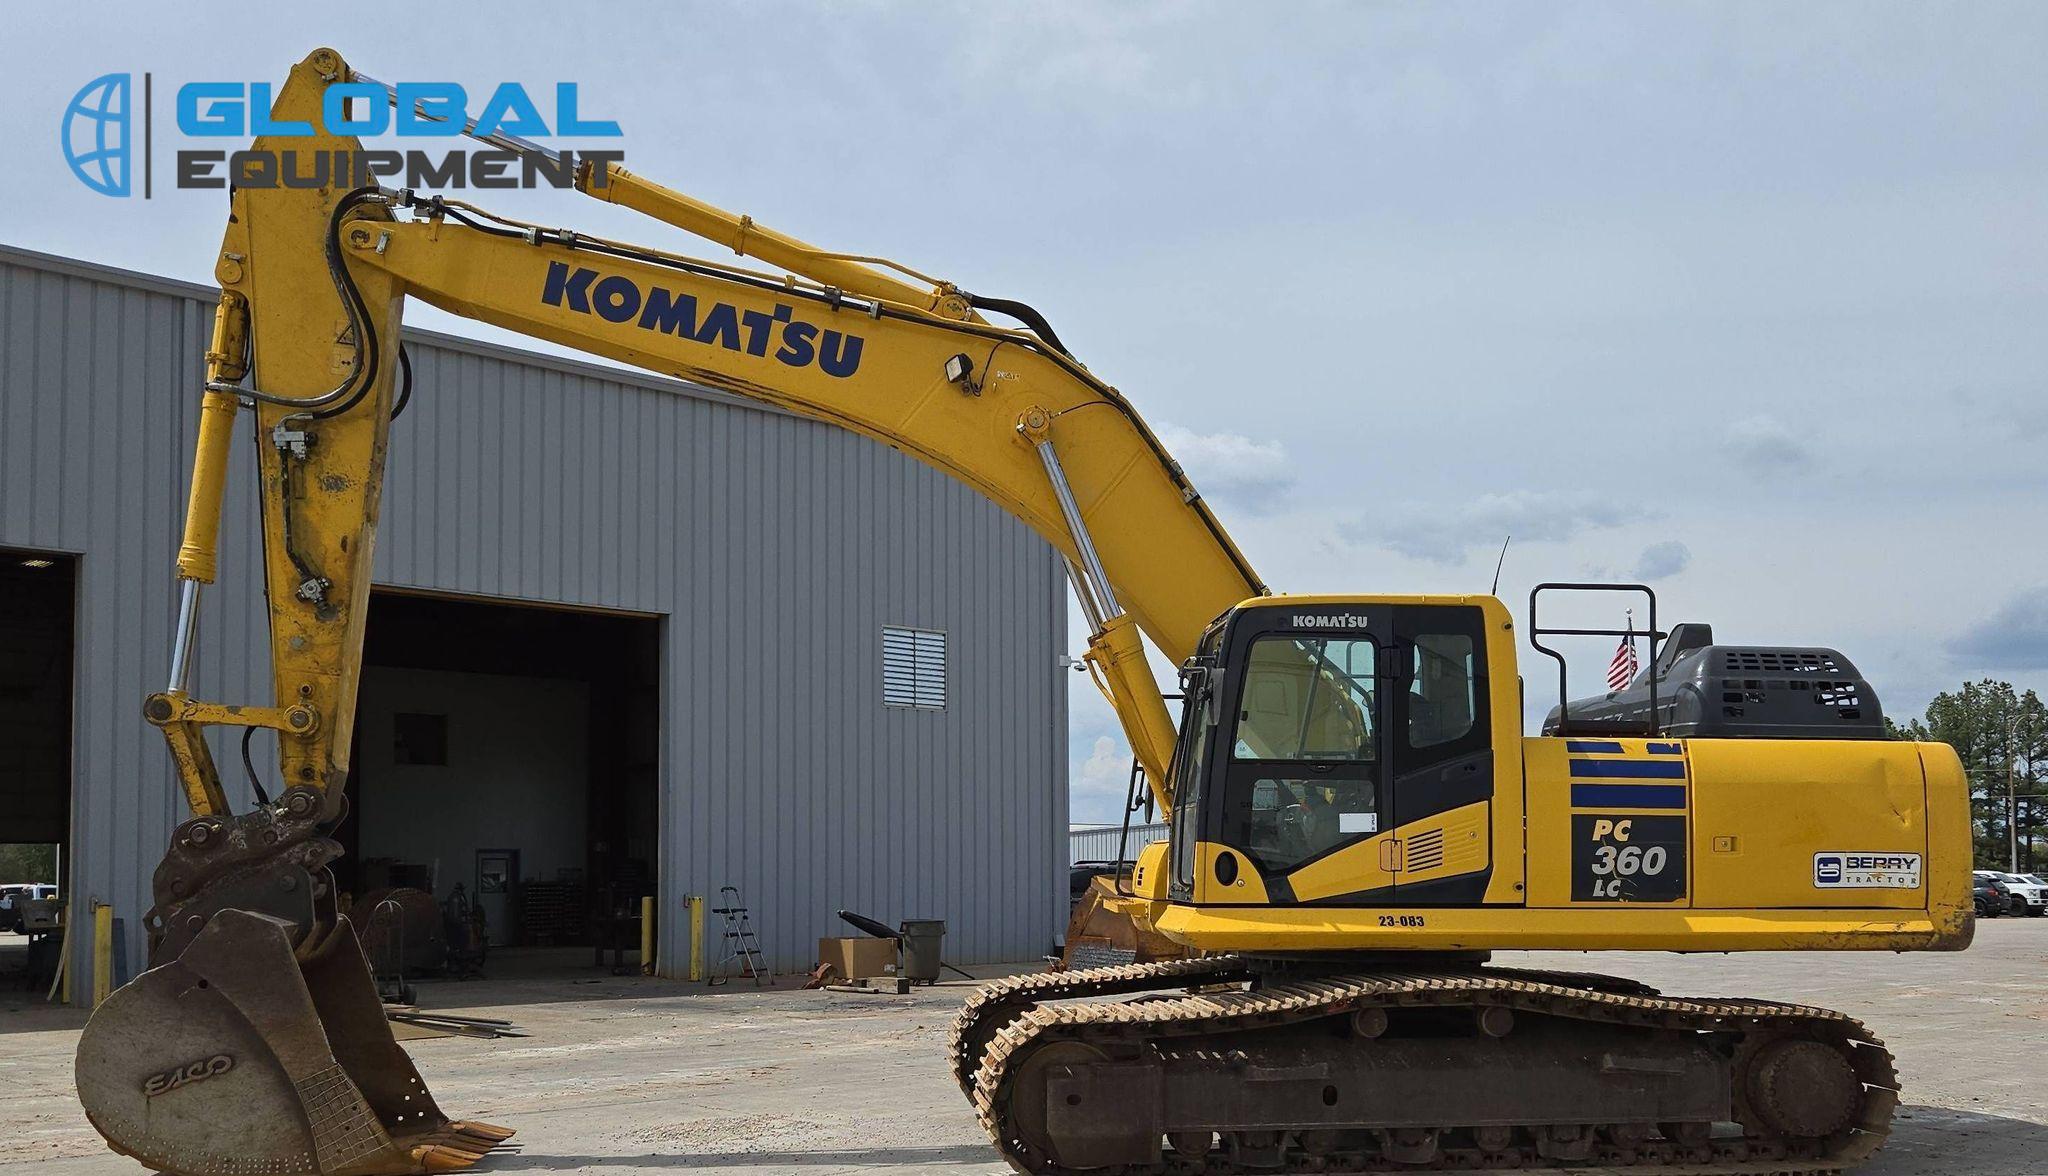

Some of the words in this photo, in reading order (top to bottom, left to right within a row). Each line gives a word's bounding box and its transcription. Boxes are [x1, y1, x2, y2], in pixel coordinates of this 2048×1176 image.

[542, 261, 864, 378] KOMATSU
[1293, 613, 1367, 627] KOMATSU
[1592, 819, 1632, 842] PC
[1591, 846, 1667, 876] 360
[1846, 857, 1917, 869] BERRY
[1593, 879, 1621, 897] LC
[1378, 915, 1424, 927] 23-083
